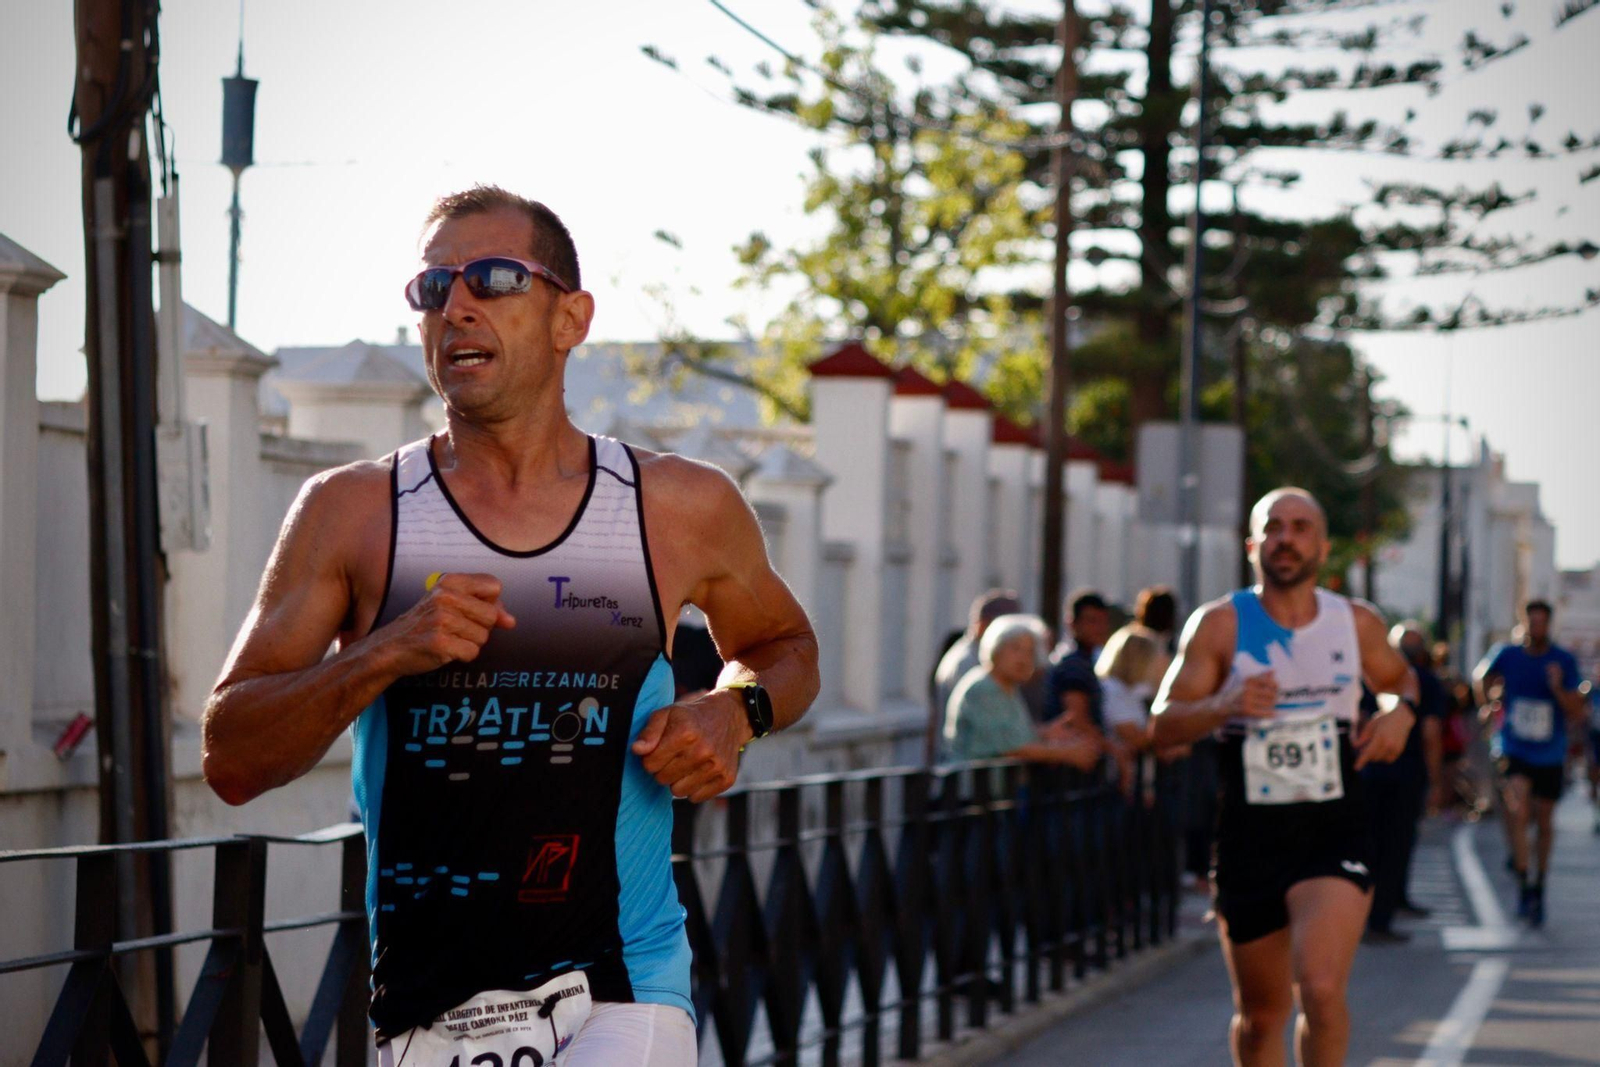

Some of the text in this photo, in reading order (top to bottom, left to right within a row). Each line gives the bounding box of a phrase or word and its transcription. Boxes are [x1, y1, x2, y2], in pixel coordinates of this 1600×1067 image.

[610, 611, 643, 628] Xerez
[408, 673, 488, 688] SCUELA
[1267, 742, 1317, 770] 691
[448, 1008, 483, 1021] SARGENTO
[485, 1004, 496, 1014] DE
[470, 1015, 506, 1030] CARMONA
[509, 1011, 529, 1023] PÁEZ
